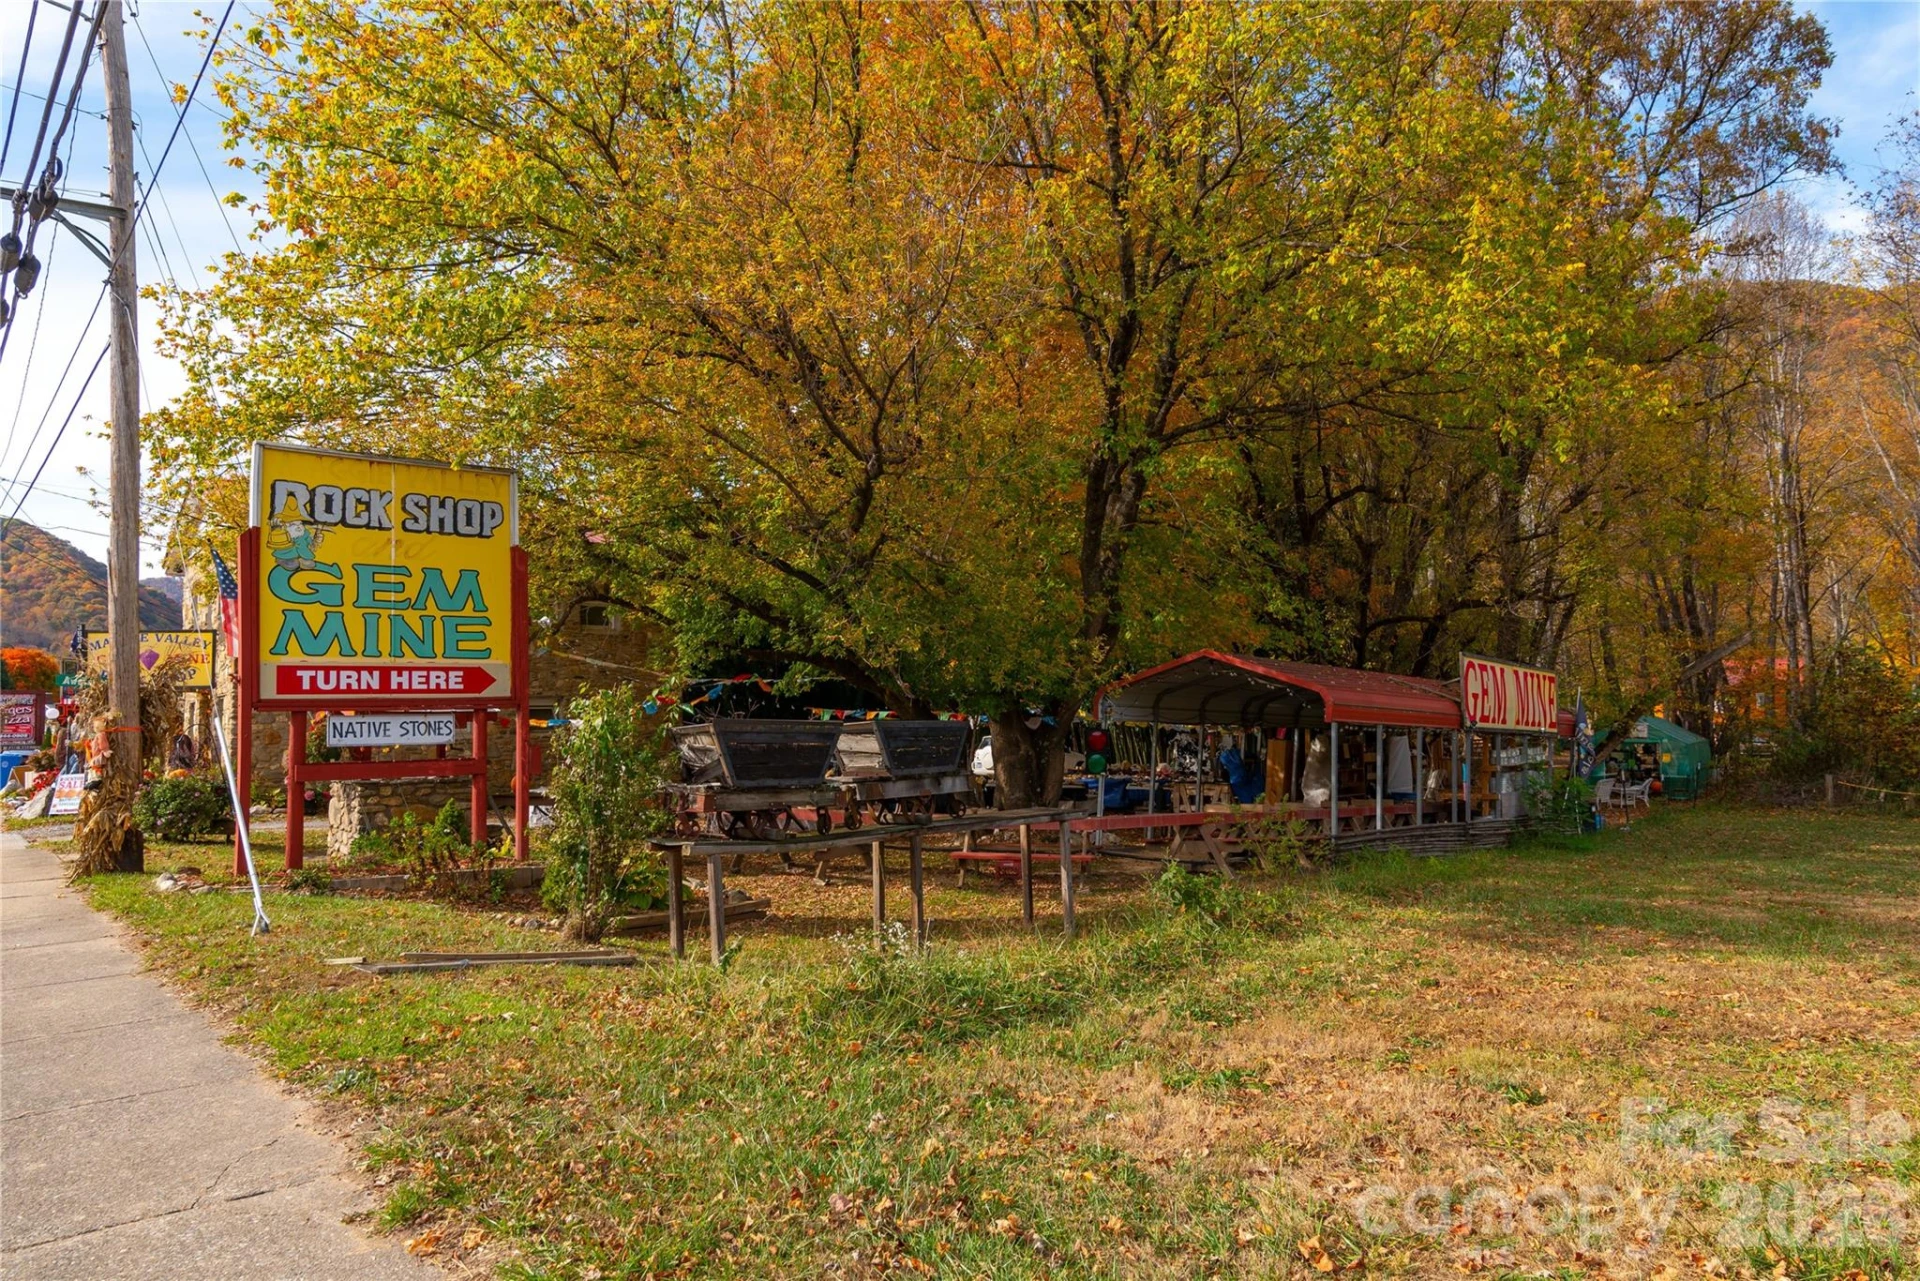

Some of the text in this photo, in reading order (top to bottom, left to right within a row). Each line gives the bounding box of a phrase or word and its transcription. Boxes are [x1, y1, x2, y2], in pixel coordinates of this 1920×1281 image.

[269, 479, 504, 538] ROCK SHOP
[268, 560, 488, 612] GEM
[89, 633, 148, 651] MAE
[155, 633, 212, 649] VALLEY
[269, 608, 492, 659] MINE
[296, 669, 465, 691] TURN HERE
[1464, 660, 1557, 729] GEM MINE
[332, 720, 453, 739] NATIVE STONES
